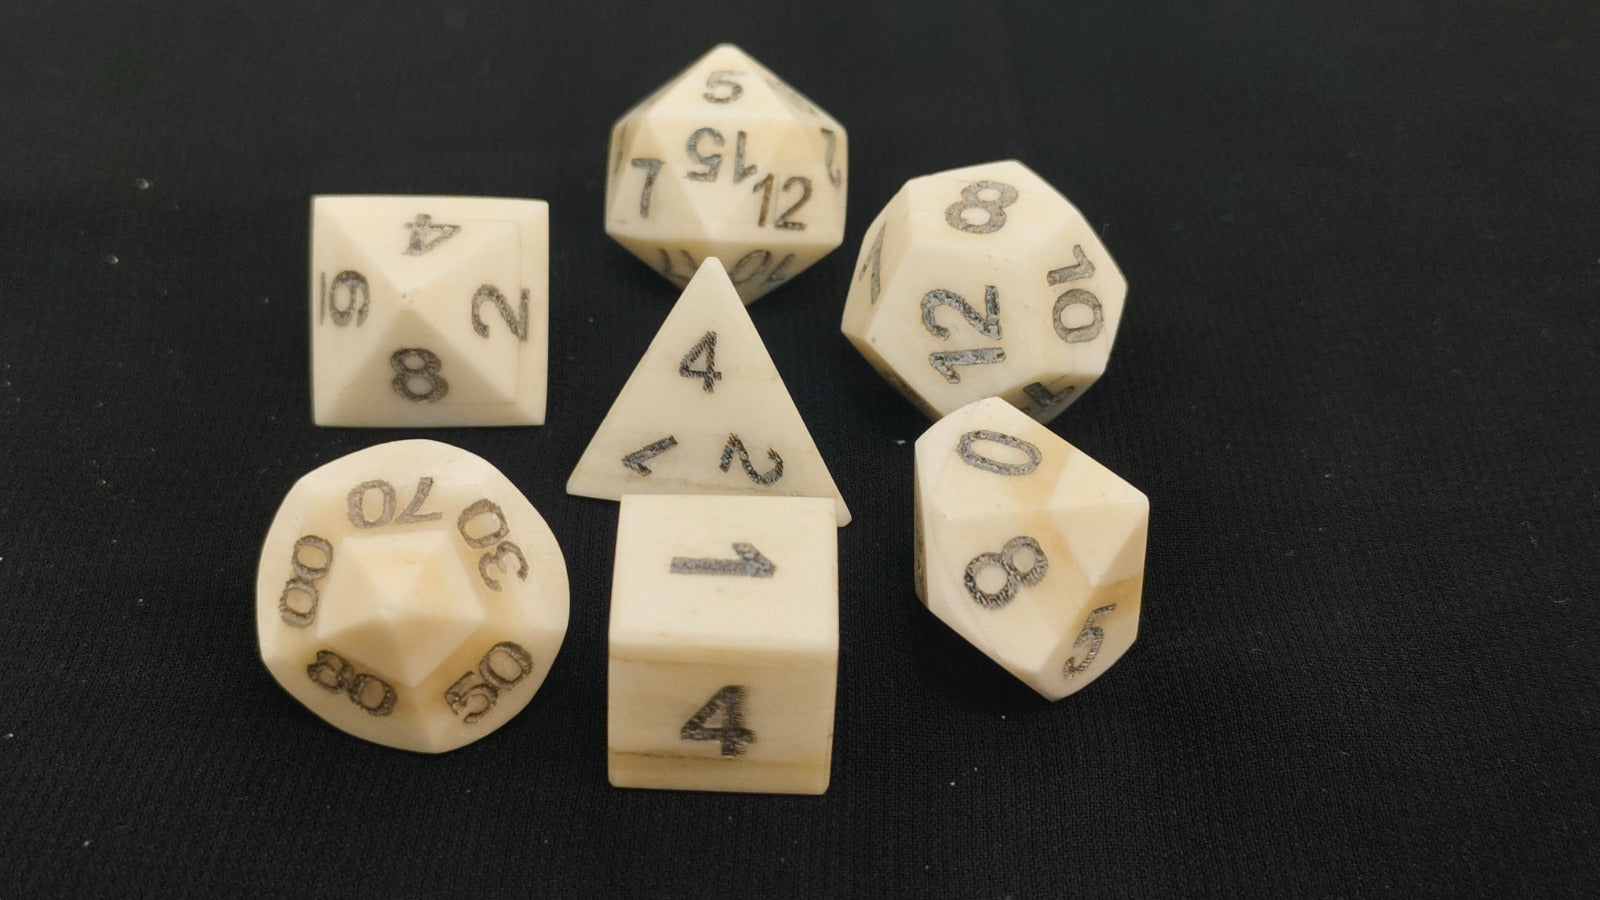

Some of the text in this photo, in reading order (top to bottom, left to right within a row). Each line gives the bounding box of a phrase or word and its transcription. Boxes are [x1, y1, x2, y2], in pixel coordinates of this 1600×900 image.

[702, 70, 746, 104] 5
[681, 127, 758, 185] 15
[630, 157, 665, 220] 7
[752, 172, 813, 231] 12
[944, 180, 1019, 235] 8
[402, 213, 462, 257] 4
[472, 283, 531, 343] 2
[1046, 244, 1105, 344] 10
[679, 331, 722, 393] 4
[920, 284, 1007, 384] 12
[390, 348, 449, 404] 8
[621, 435, 678, 476] 1
[719, 432, 784, 485] 2
[956, 429, 1043, 476] 0
[346, 476, 443, 529] 70
[456, 498, 530, 592] 30
[669, 542, 776, 578] 1
[963, 535, 1049, 610] 8
[278, 534, 334, 628] 00
[1062, 602, 1117, 680] 5
[306, 649, 398, 717] 80
[444, 641, 534, 725] 50
[680, 684, 757, 759] 4
